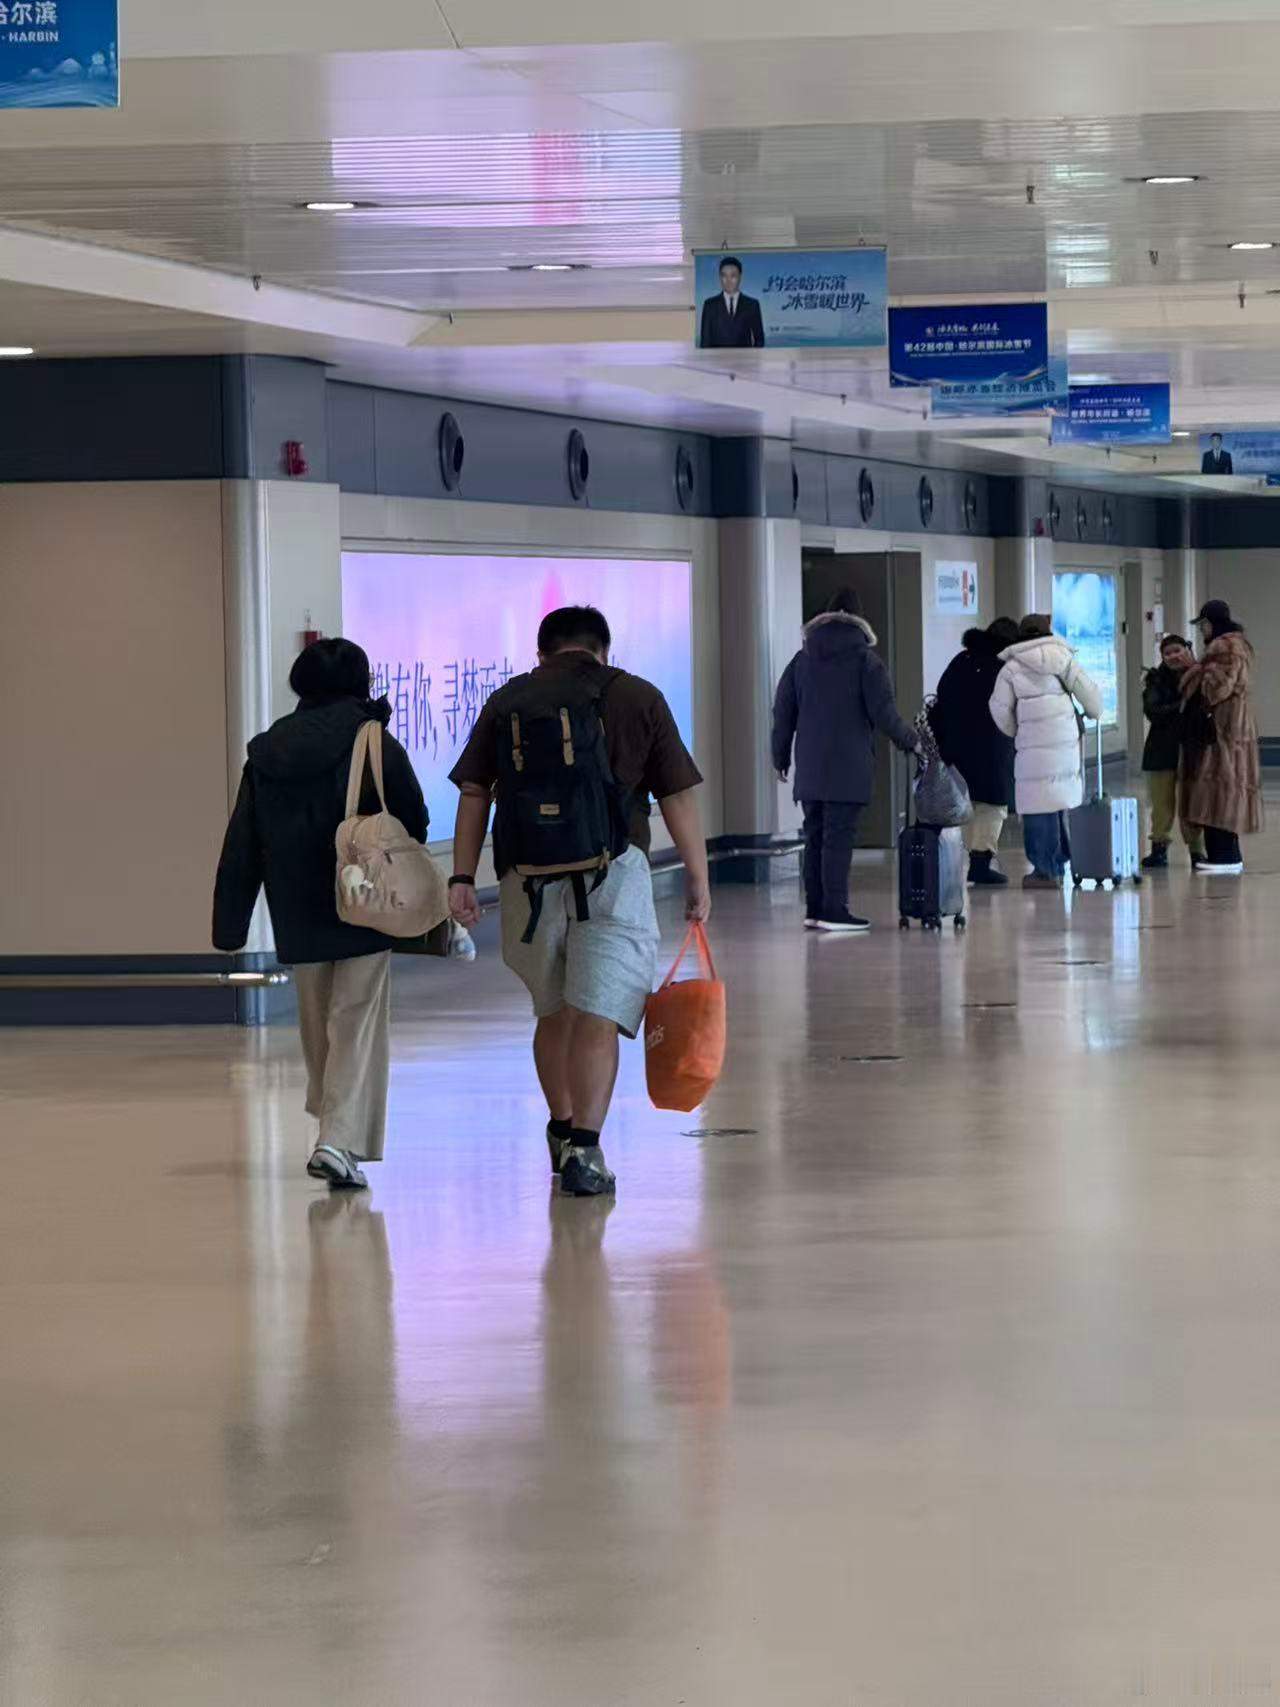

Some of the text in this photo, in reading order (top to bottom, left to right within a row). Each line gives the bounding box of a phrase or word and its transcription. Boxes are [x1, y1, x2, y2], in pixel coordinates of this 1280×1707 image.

[9, 31, 59, 42] HARBIN
[762, 274, 847, 293] 约会哈尔滨
[781, 292, 870, 313] 冰雪暖世界
